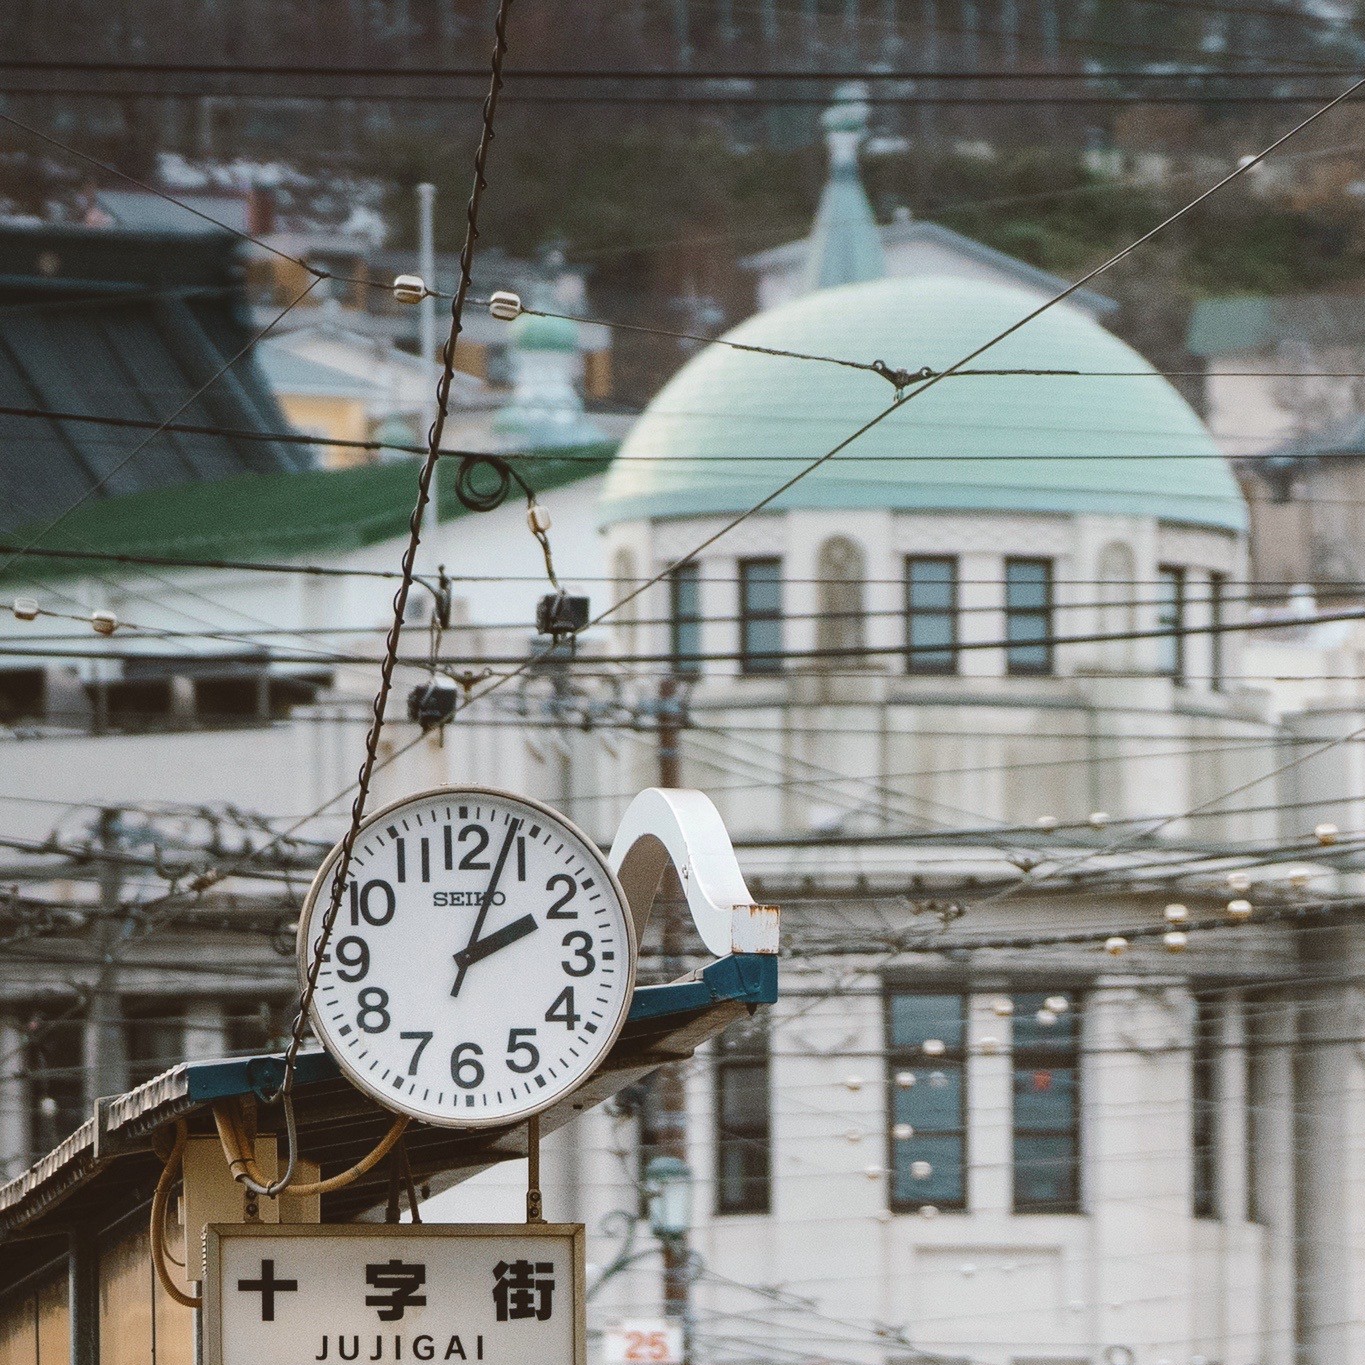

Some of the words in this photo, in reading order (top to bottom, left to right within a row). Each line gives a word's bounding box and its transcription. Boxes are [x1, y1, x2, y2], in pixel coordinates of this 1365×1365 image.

[396, 836, 430, 883] 11
[443, 824, 491, 871] 12
[350, 879, 396, 927] 10
[432, 891, 507, 907] SEIKO
[545, 874, 579, 920] 2
[335, 935, 370, 982] 9
[561, 930, 595, 978] 3
[356, 986, 390, 1034] 8
[544, 986, 580, 1031] 4
[400, 1031, 434, 1076] 7
[449, 1042, 484, 1089] 6
[505, 1028, 538, 1074] 5
[237, 1259, 555, 1322] 十字街
[315, 1335, 486, 1361] JUJIGAI
